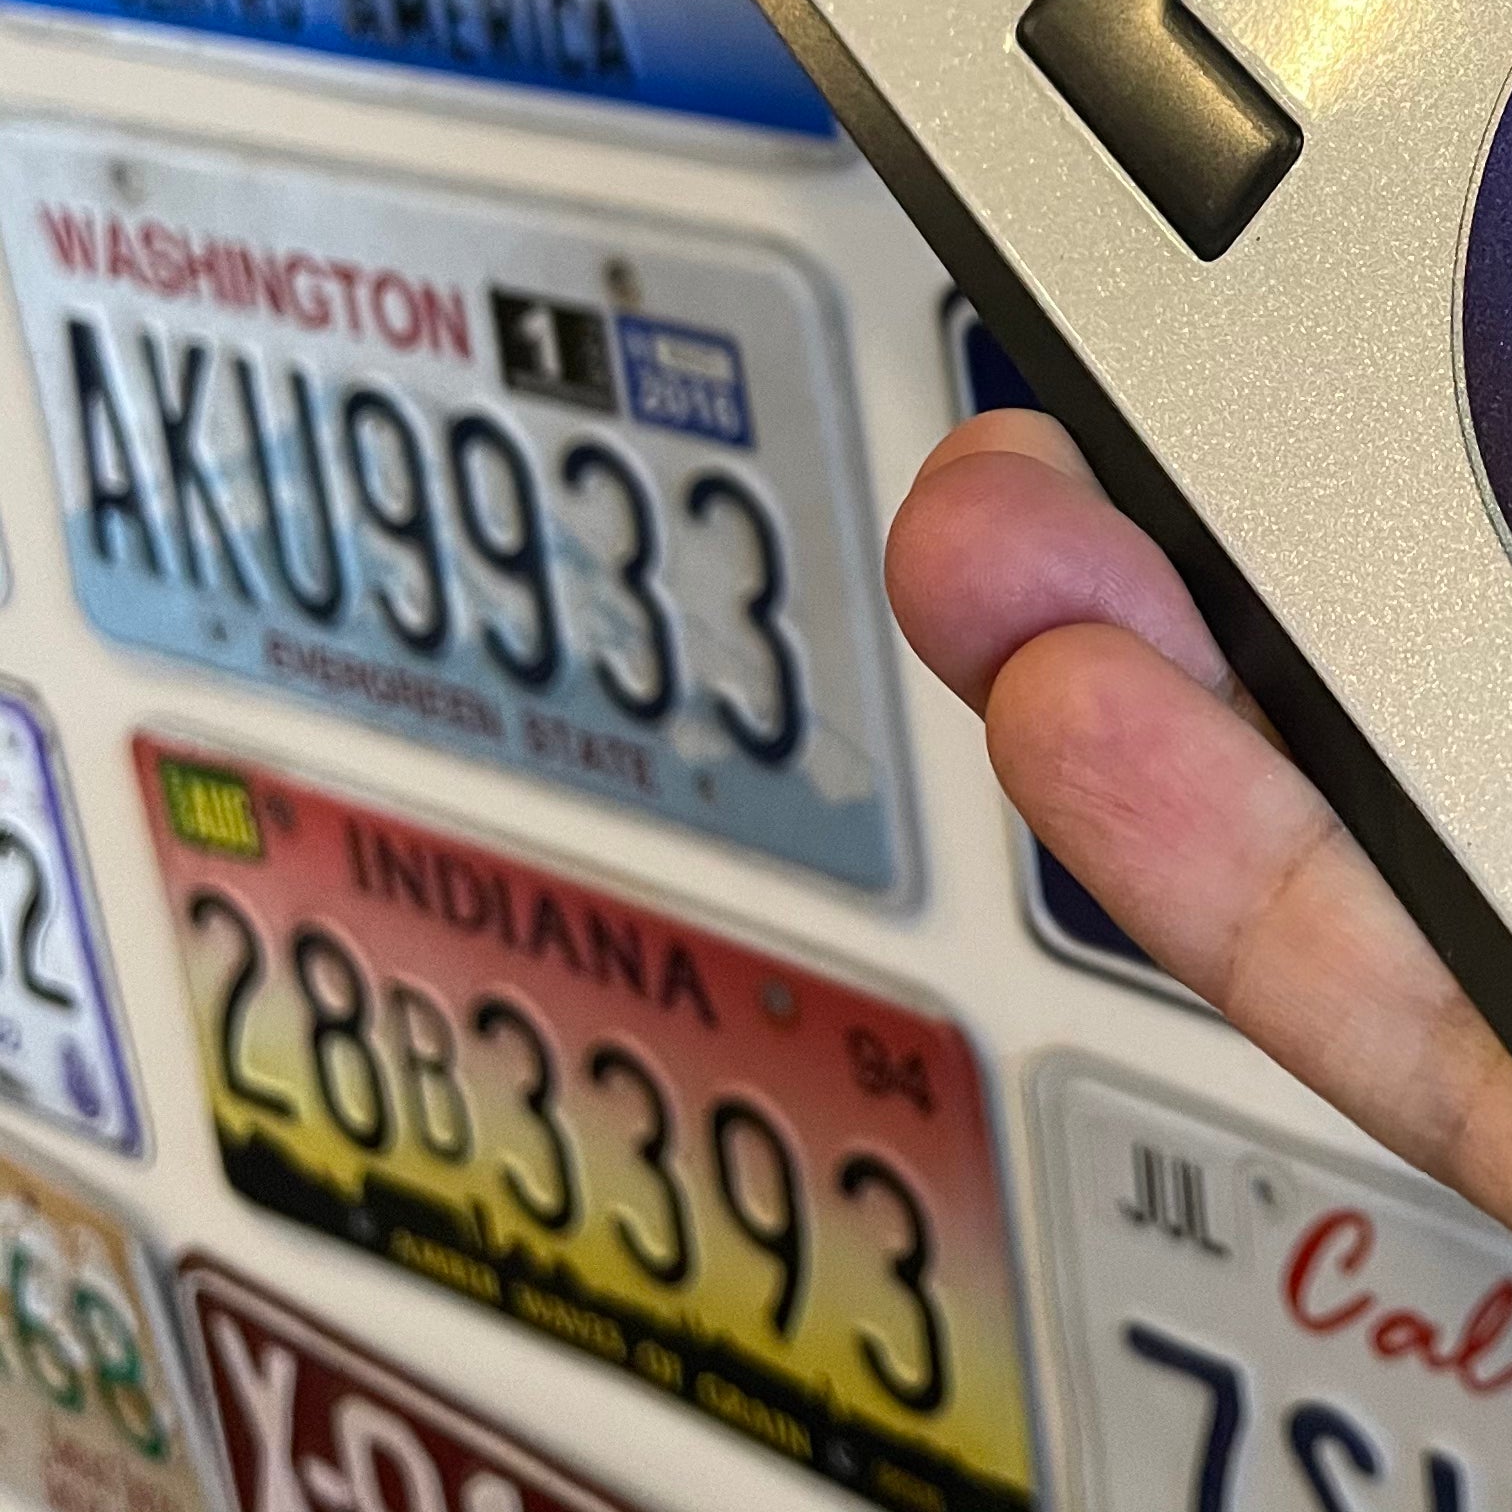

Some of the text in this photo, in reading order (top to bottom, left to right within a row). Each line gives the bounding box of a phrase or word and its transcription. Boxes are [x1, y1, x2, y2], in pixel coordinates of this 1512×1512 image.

[36, 198, 475, 366] WASHINGTON
[62, 310, 808, 766] AKU9933
[340, 816, 718, 1033] INDIANA
[190, 888, 955, 1418] 28B3393
[1114, 1138, 1236, 1262] JUL
